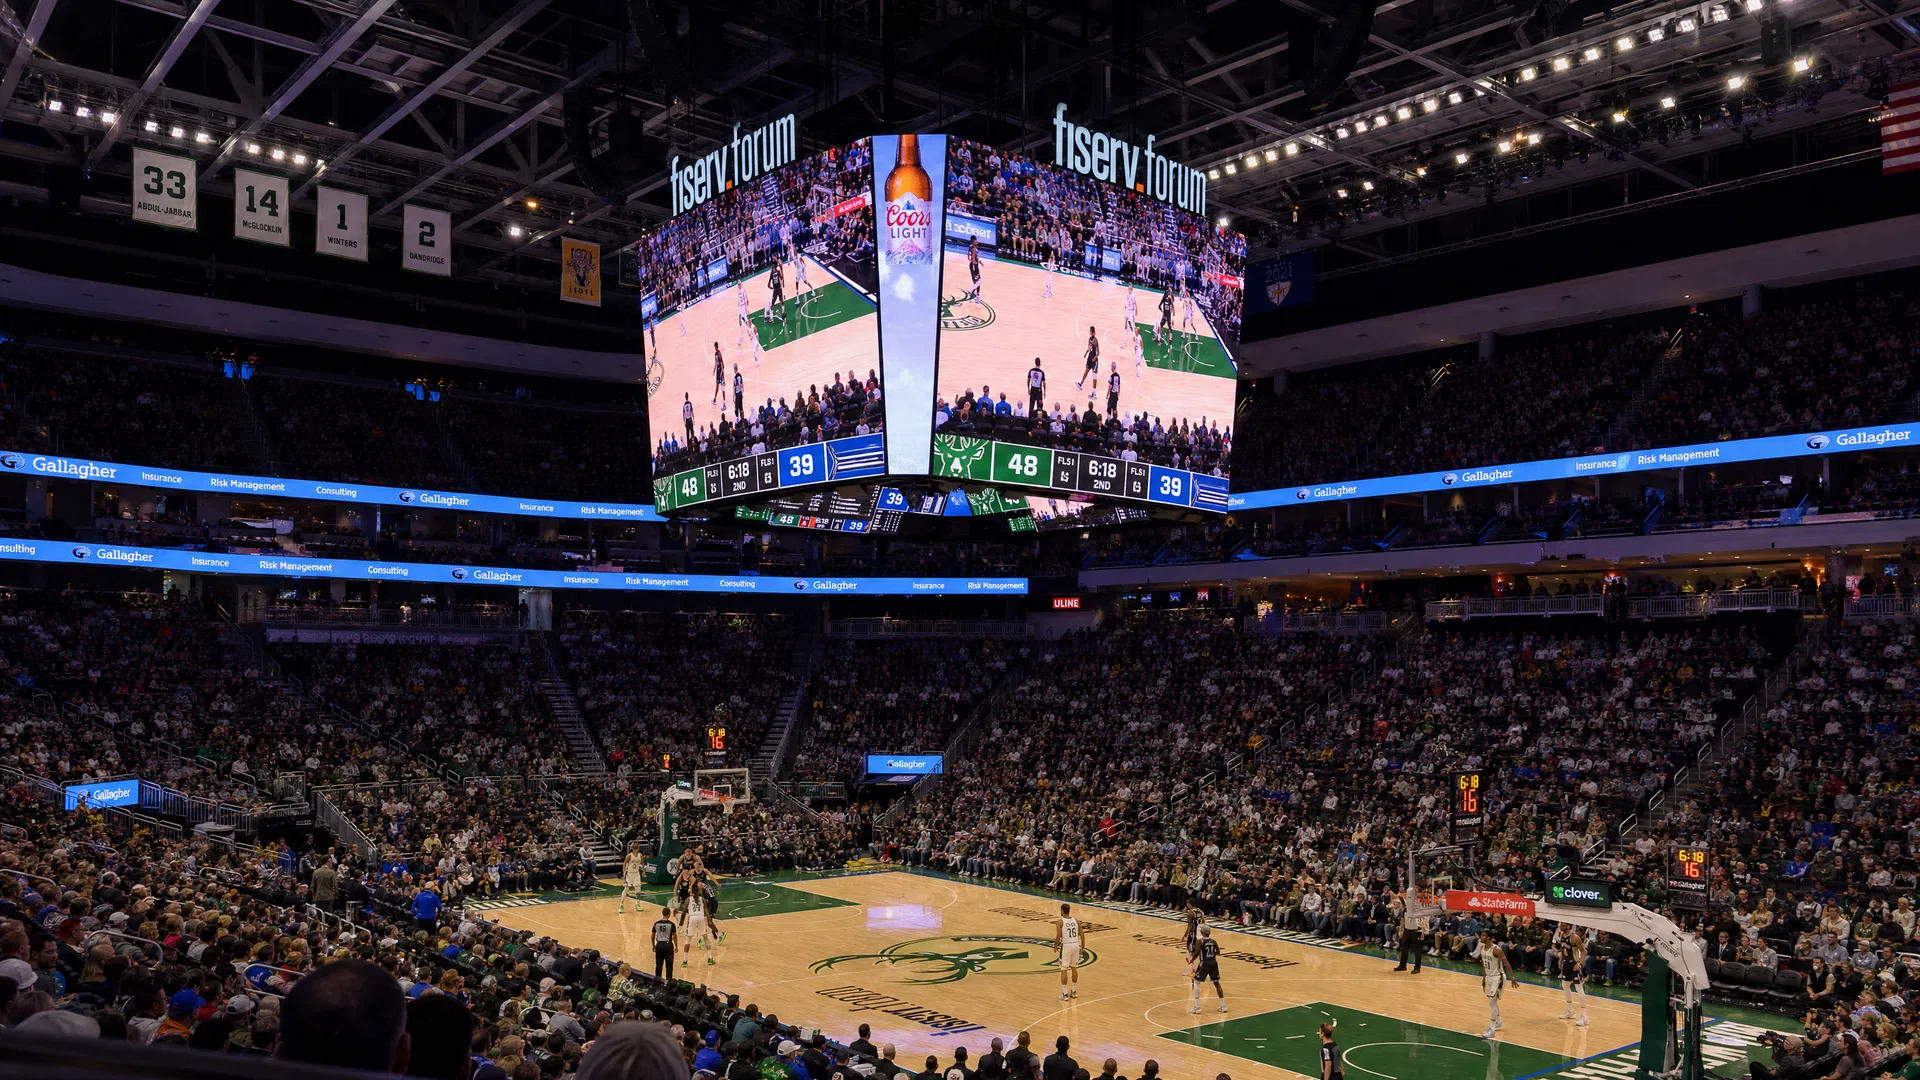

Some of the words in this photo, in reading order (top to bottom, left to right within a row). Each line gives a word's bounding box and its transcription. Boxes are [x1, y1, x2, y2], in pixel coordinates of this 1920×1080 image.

[670, 113, 796, 217] fiserv.forum
[1053, 102, 1207, 216] fiserv.forum
[144, 166, 187, 200] 33
[137, 201, 192, 219] ABDUL-JABBAR
[245, 185, 279, 217] 14
[336, 203, 348, 230] 1
[886, 204, 931, 227] Coors
[242, 219, 282, 234] McGLOCKLIN
[418, 220, 436, 248] 2
[891, 227, 927, 239] LIGHT
[327, 236, 358, 248] WINTERS
[409, 252, 445, 265] DANDRIDGE
[1265, 265, 1292, 283] 2021
[728, 462, 750, 480] 6:18
[789, 453, 814, 477] 39
[1008, 453, 1038, 476] 48
[1088, 459, 1117, 478] 6:18
[1313, 485, 1357, 498] Gallagher
[1461, 468, 1513, 483] Gallagher
[1575, 459, 1617, 471] Insurance
[1638, 455, 1657, 465] Risk
[1659, 447, 1720, 463] Management
[1836, 428, 1912, 447] Gallagher
[33, 457, 117, 479] Gallagher
[142, 472, 182, 483] Insurance
[211, 478, 229, 487] Risk
[233, 480, 285, 492] Management
[316, 486, 357, 498] Consulting
[420, 494, 469, 506] Gallagher
[520, 503, 554, 512] Insurance
[581, 506, 596, 515] Risk
[598, 507, 644, 517] Management
[682, 476, 698, 498] 48
[732, 481, 747, 492] 2ND
[1093, 481, 1111, 491] 2ND
[1160, 475, 1182, 497] 39
[886, 492, 904, 505] 39
[779, 515, 794, 525] 48
[849, 522, 863, 531] 39
[97, 549, 153, 562] Gallagher
[192, 557, 229, 567] Insurance
[260, 561, 278, 570] Risk
[280, 562, 333, 573] Management
[368, 566, 408, 576] Consulting
[474, 570, 522, 582] Gallagher
[625, 577, 641, 586] Risk
[642, 578, 689, 588] Management
[720, 580, 755, 588] Consulting
[813, 581, 857, 591] Gallagher
[967, 581, 981, 589] Risk
[983, 581, 1024, 591] Management
[1055, 599, 1078, 607] ULINE
[708, 728, 726, 737] 6:18
[711, 736, 724, 750] 16
[887, 760, 925, 769] Gallagher
[1460, 774, 1479, 790] 6:18
[94, 788, 130, 800] Gallagher
[1462, 789, 1477, 812] 16
[1678, 850, 1704, 863] 6:18
[1684, 862, 1699, 878] 16
[1564, 888, 1600, 900] clover
